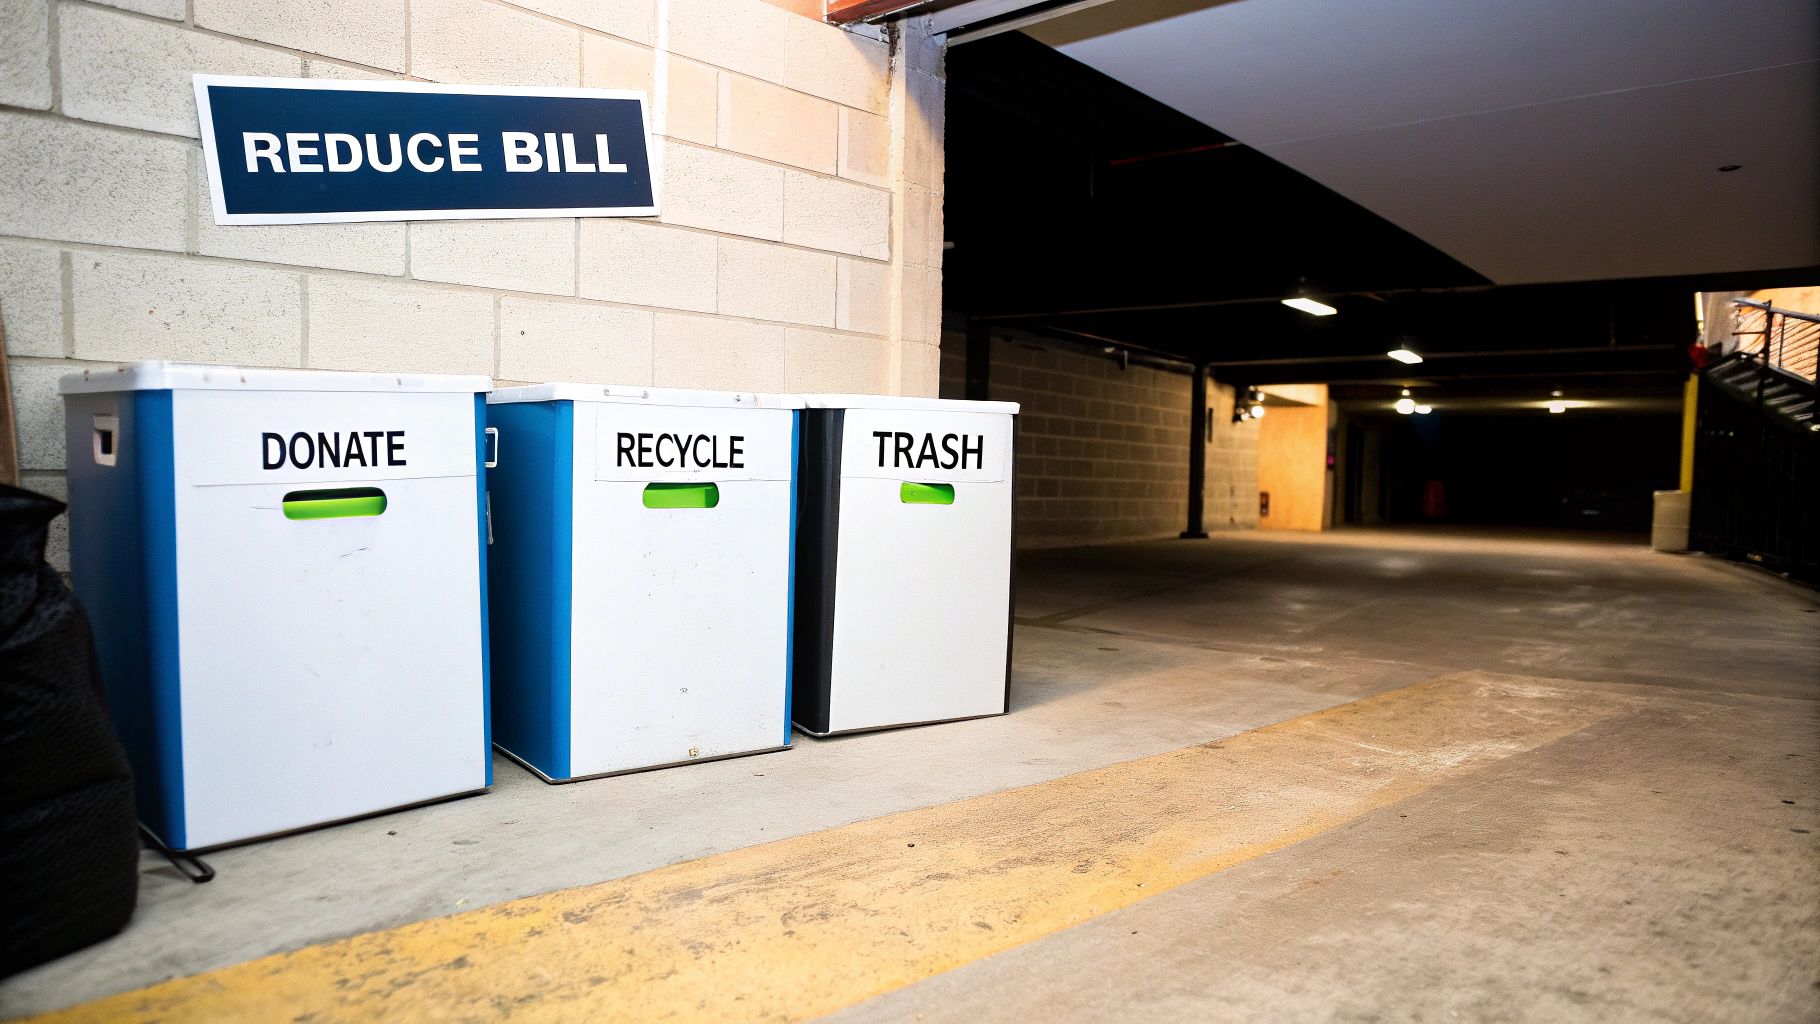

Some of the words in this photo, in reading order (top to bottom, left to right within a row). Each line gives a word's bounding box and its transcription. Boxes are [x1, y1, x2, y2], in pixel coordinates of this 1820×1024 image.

[242, 131, 483, 174] REDUCE
[501, 131, 629, 174] BILL
[261, 430, 408, 470] DONATE
[616, 432, 745, 469] RECYCLE
[872, 430, 985, 470] TRASH
